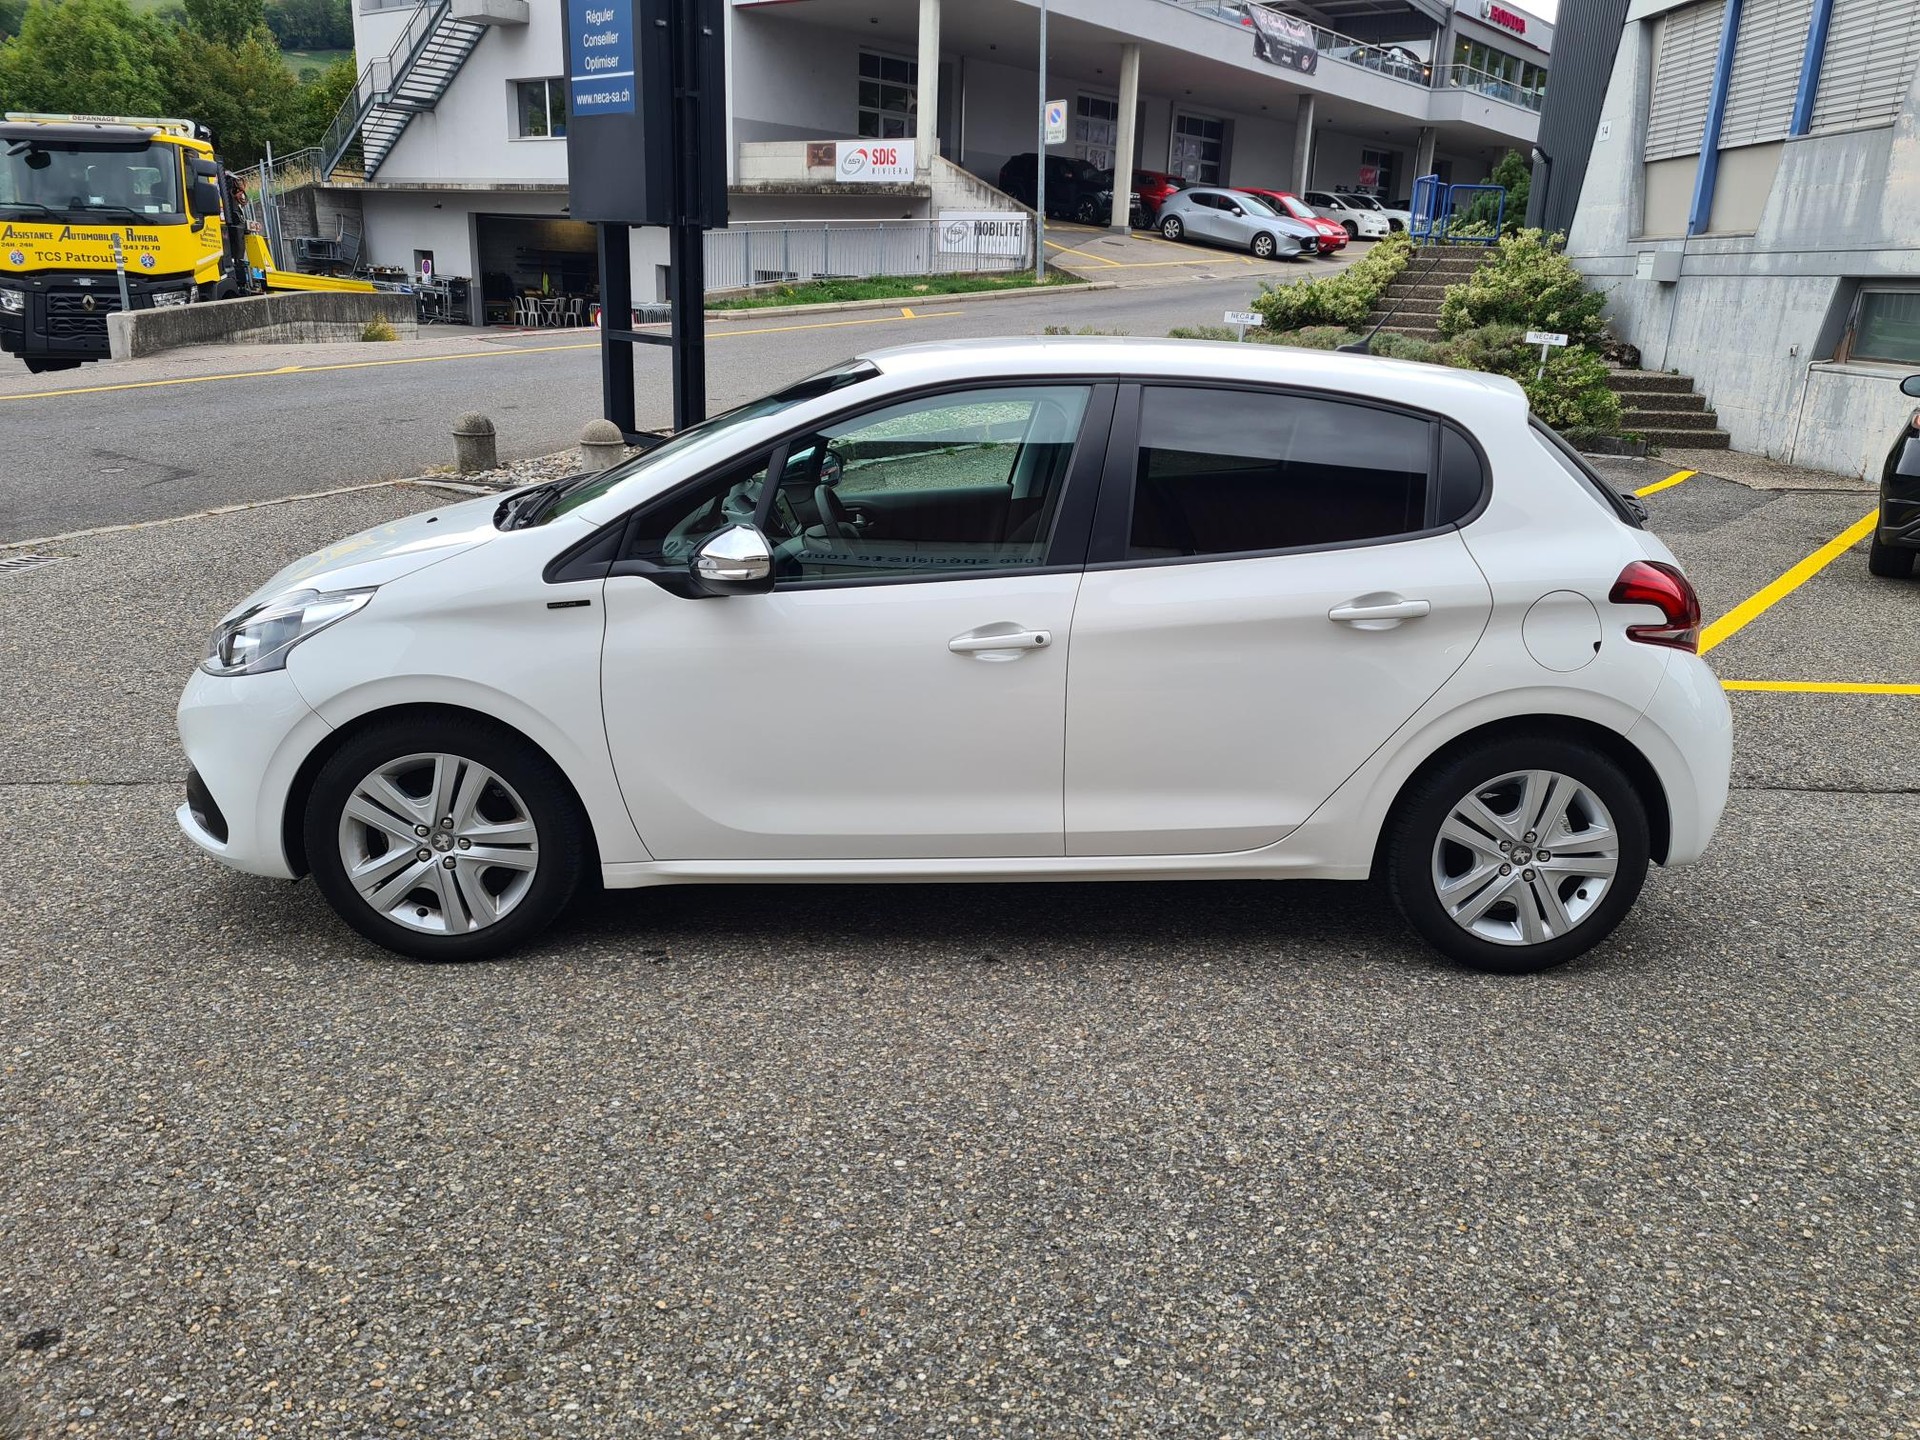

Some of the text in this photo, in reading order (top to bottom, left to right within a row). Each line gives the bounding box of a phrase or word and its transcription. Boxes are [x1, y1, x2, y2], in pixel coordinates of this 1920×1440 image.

[585, 8, 614, 26] Réguler
[1490, 5, 1527, 34] HONDA
[583, 31, 619, 48] Conseiller
[585, 56, 619, 73] Optimiser
[576, 87, 630, 105] www.neca-sa.ch
[1601, 125, 1609, 136] 14
[872, 148, 897, 165] SDIS
[871, 167, 909, 175] RIVIERA
[974, 221, 1020, 237] MOBILITE
[35, 251, 62, 262] TCS
[65, 252, 129, 264] Patrouile
[1231, 312, 1250, 320] NECA
[1533, 332, 1554, 340] NECA
